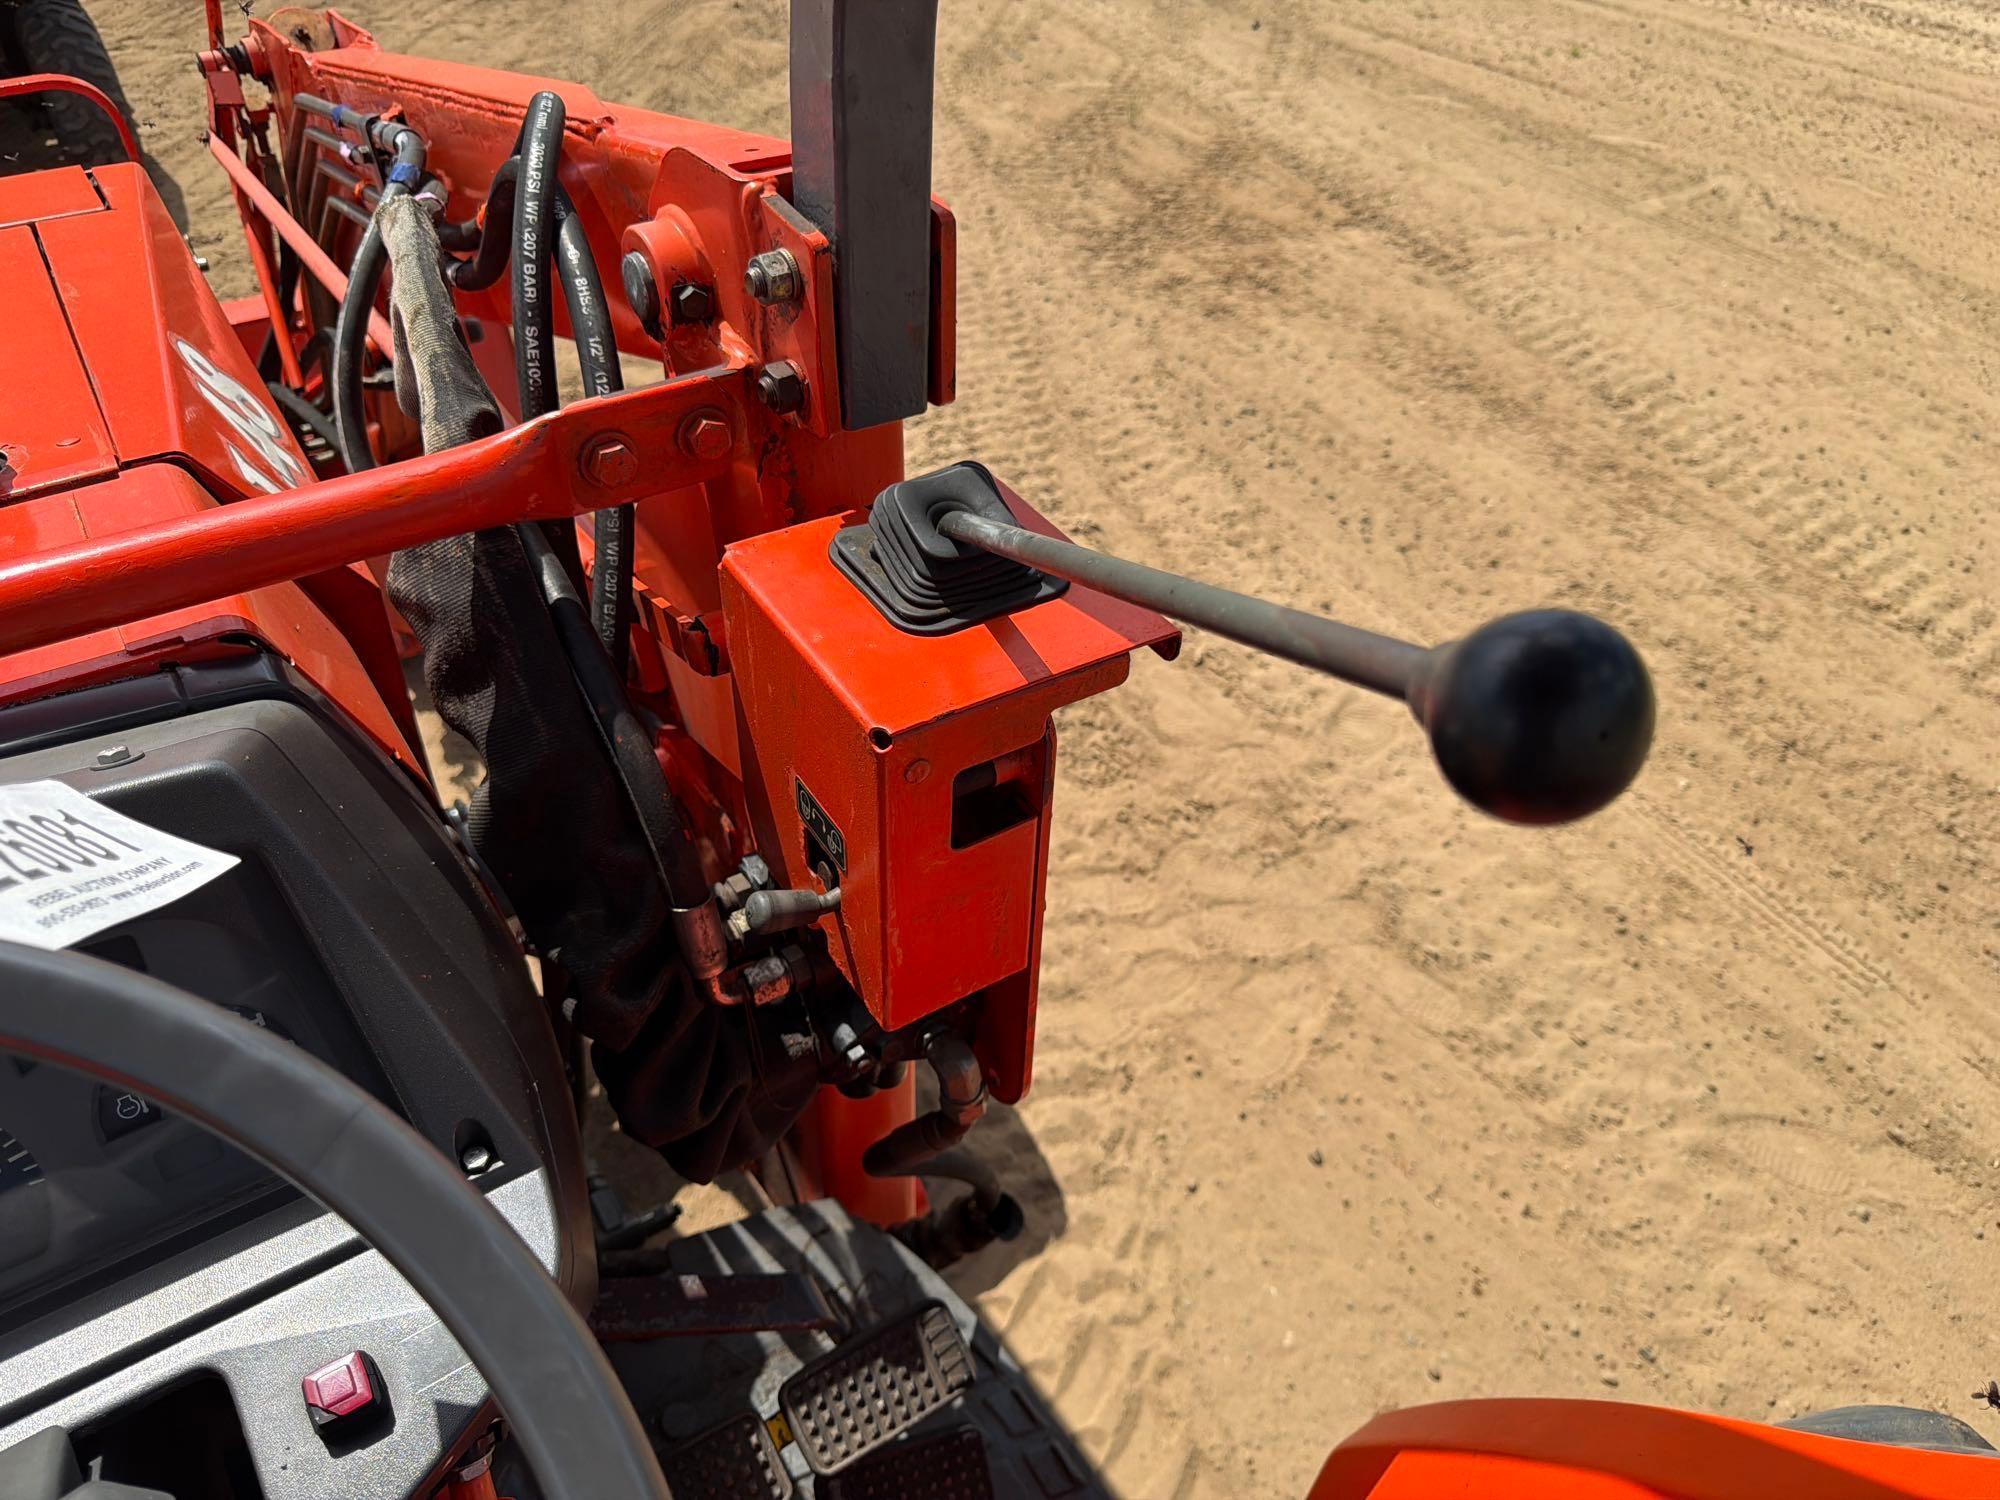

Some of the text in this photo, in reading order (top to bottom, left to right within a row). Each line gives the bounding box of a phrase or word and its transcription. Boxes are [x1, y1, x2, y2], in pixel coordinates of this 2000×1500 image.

[527, 169, 543, 194] PSI
[523, 263, 538, 304] BAR)
[595, 370, 611, 397] (12
[606, 506, 620, 533] PSI
[606, 541, 619, 566] WP
[604, 569, 618, 600] (207
[0, 808, 143, 892] 26081
[27, 856, 173, 909] REBEL AUCTION COMPANY
